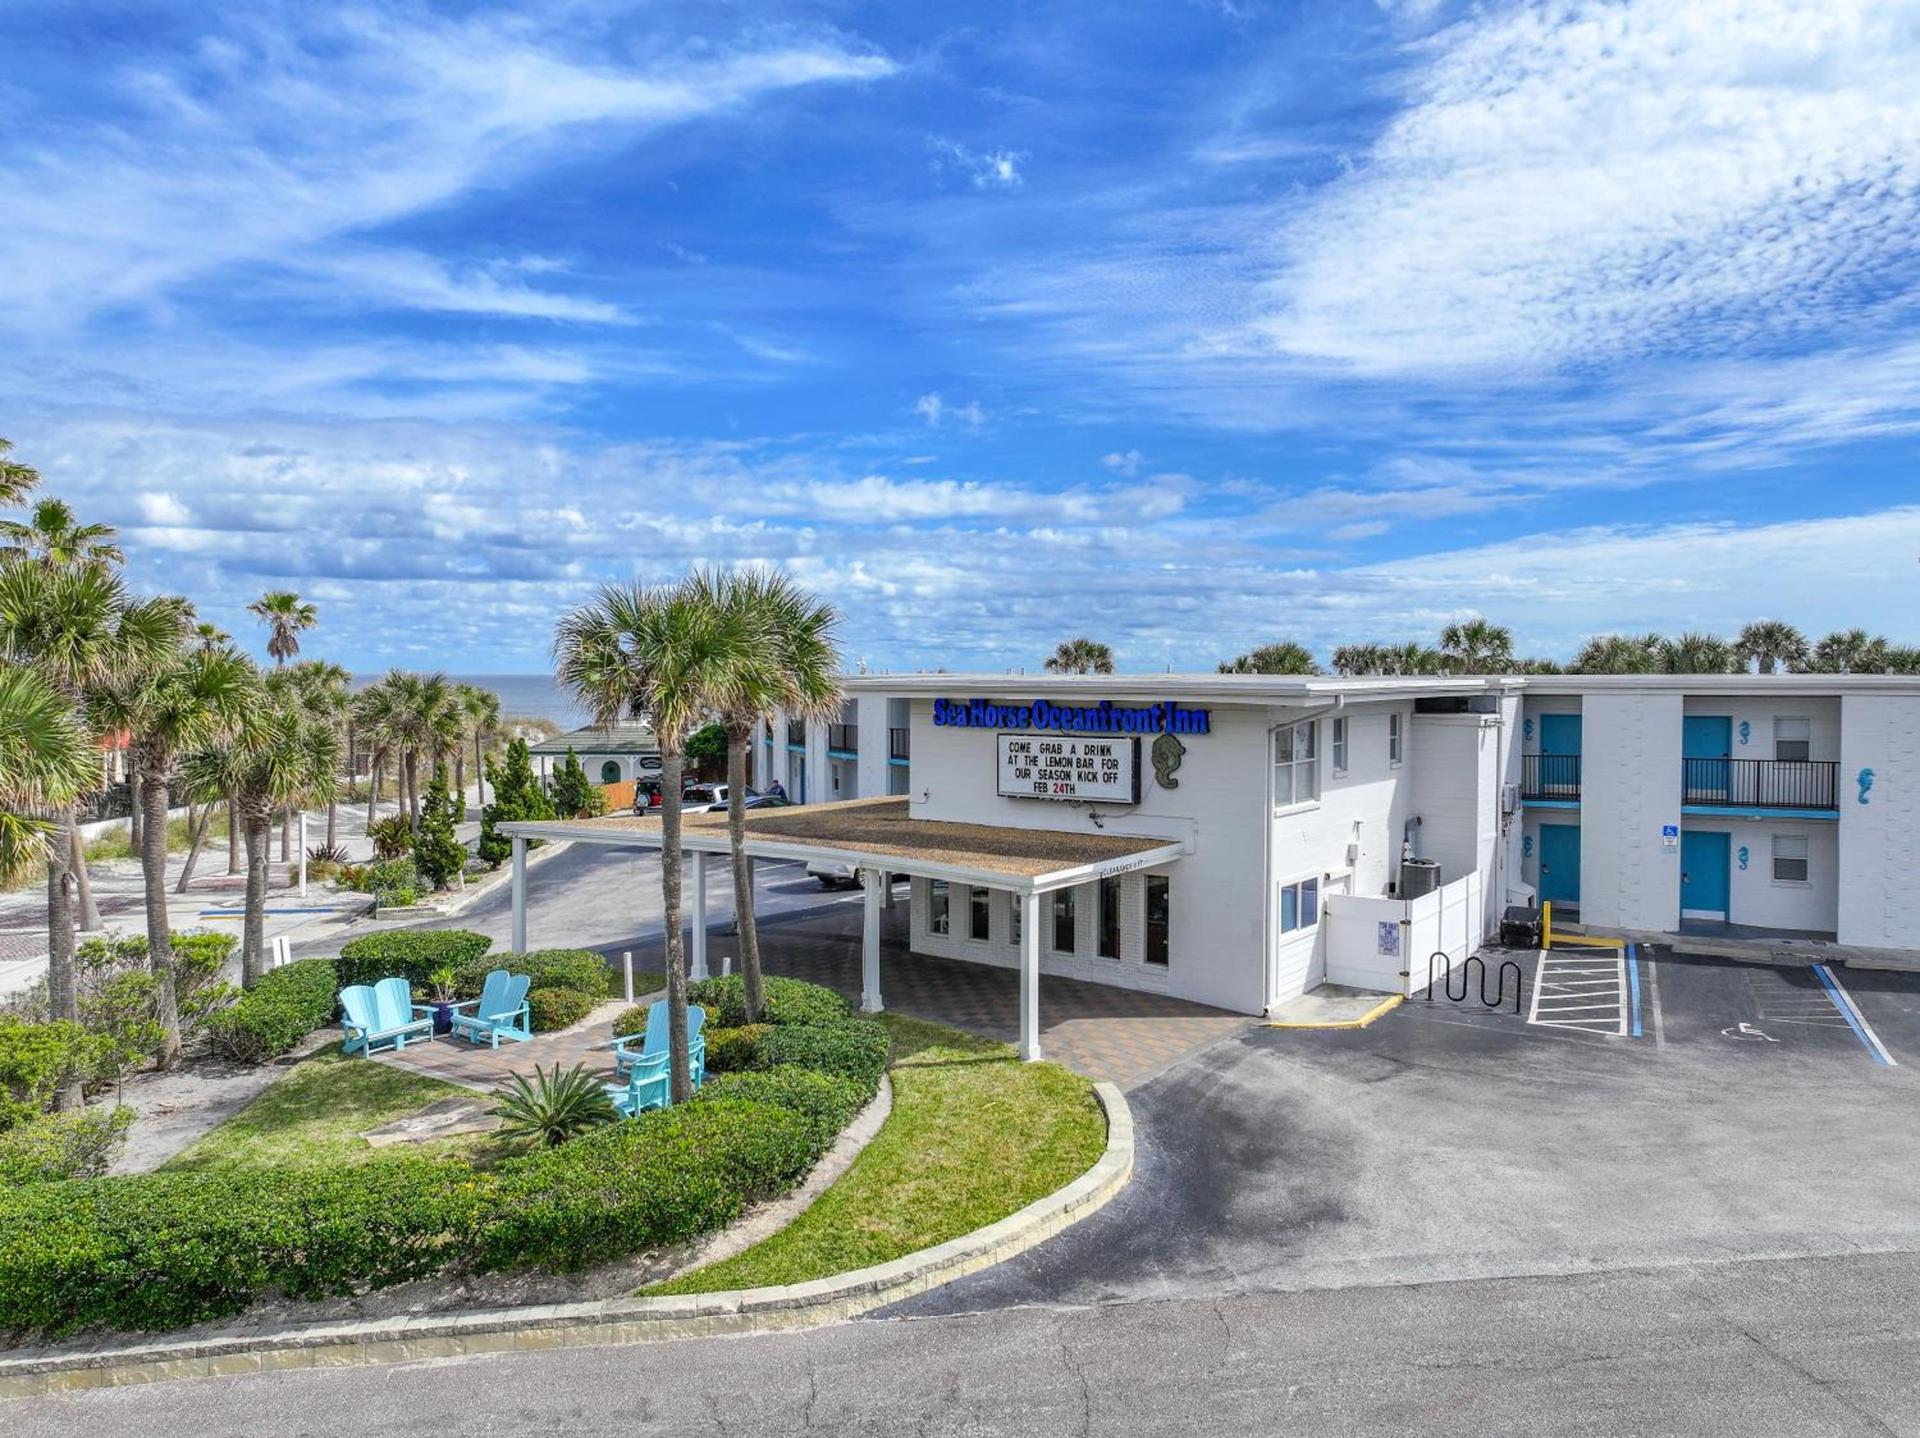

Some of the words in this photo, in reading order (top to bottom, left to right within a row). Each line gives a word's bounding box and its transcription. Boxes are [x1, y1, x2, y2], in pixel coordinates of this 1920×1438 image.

[933, 698, 968, 727] Sea
[968, 698, 1030, 729] Horse
[1032, 699, 1163, 734] Oceanfront
[1163, 701, 1212, 735] Inn
[1009, 742, 1031, 754] COME
[1039, 743, 1063, 754] GRAB
[1070, 744, 1077, 755] A
[1084, 744, 1112, 756] DRINK
[1008, 755, 1018, 766] AT
[1024, 755, 1039, 767] THE
[1045, 756, 1073, 768] LEMON
[1076, 757, 1094, 769] BAR
[1101, 758, 1119, 770] FOR
[1015, 767, 1031, 779] OUR
[1038, 769, 1071, 781] SEASON
[1077, 771, 1098, 783] KICK
[1102, 772, 1118, 784] OFF
[1033, 781, 1048, 793] FEB
[1053, 783, 1076, 794] 24TH
